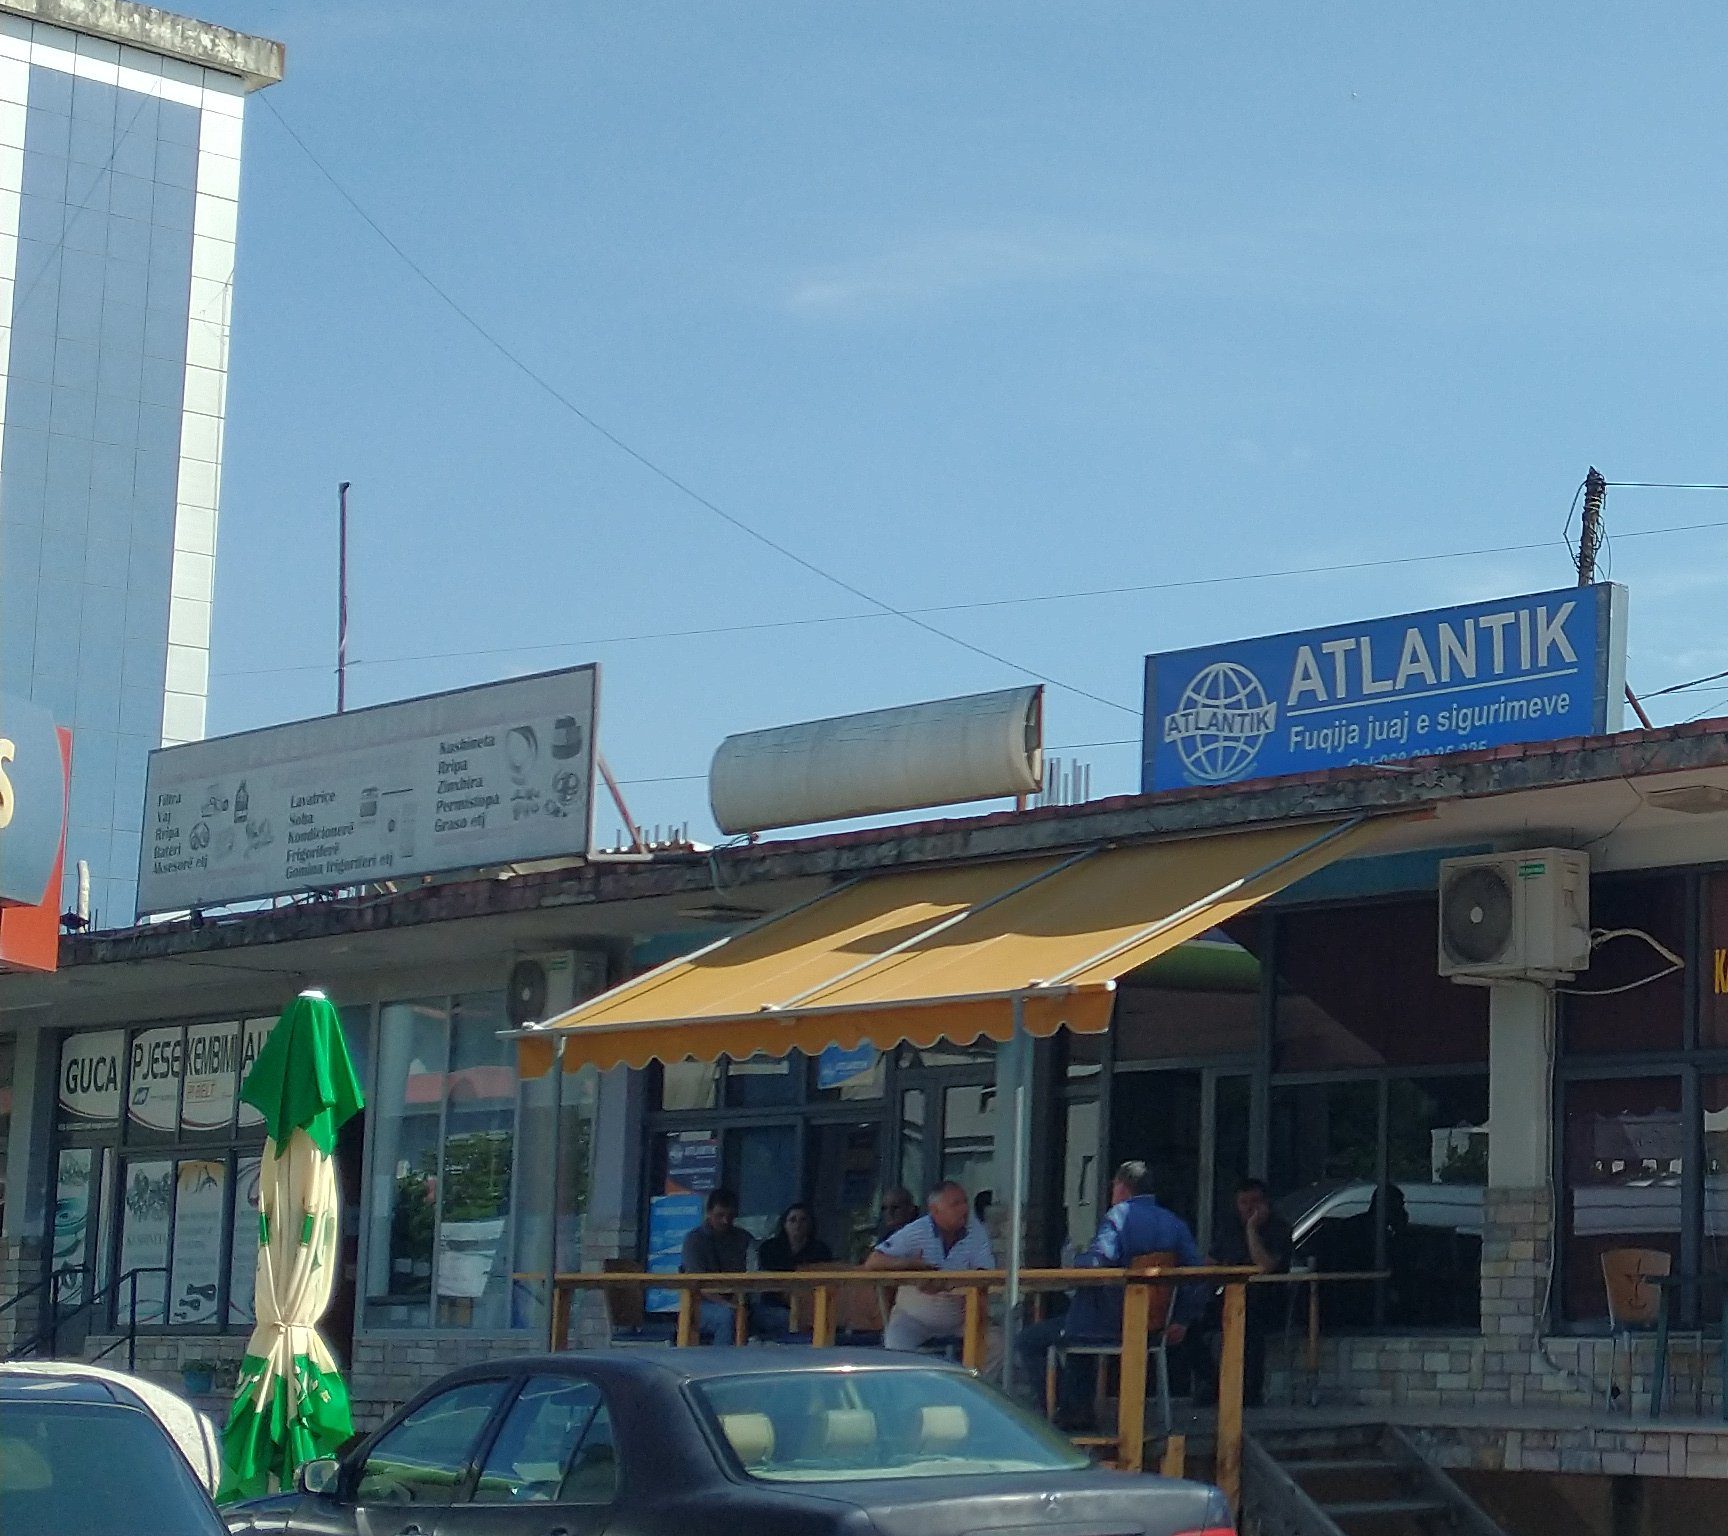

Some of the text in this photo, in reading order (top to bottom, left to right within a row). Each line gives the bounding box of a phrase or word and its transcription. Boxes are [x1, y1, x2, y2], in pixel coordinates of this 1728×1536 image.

[1286, 602, 1578, 706] ATLANTIK
[1166, 709, 1271, 735] ATLANTIK
[1290, 718, 1360, 754] Fuqija
[1364, 711, 1409, 749] juaj
[1417, 715, 1431, 734] e
[1436, 692, 1571, 735] sigurimeve
[65, 1056, 118, 1094] GUCA
[132, 1040, 181, 1081] PJESE
